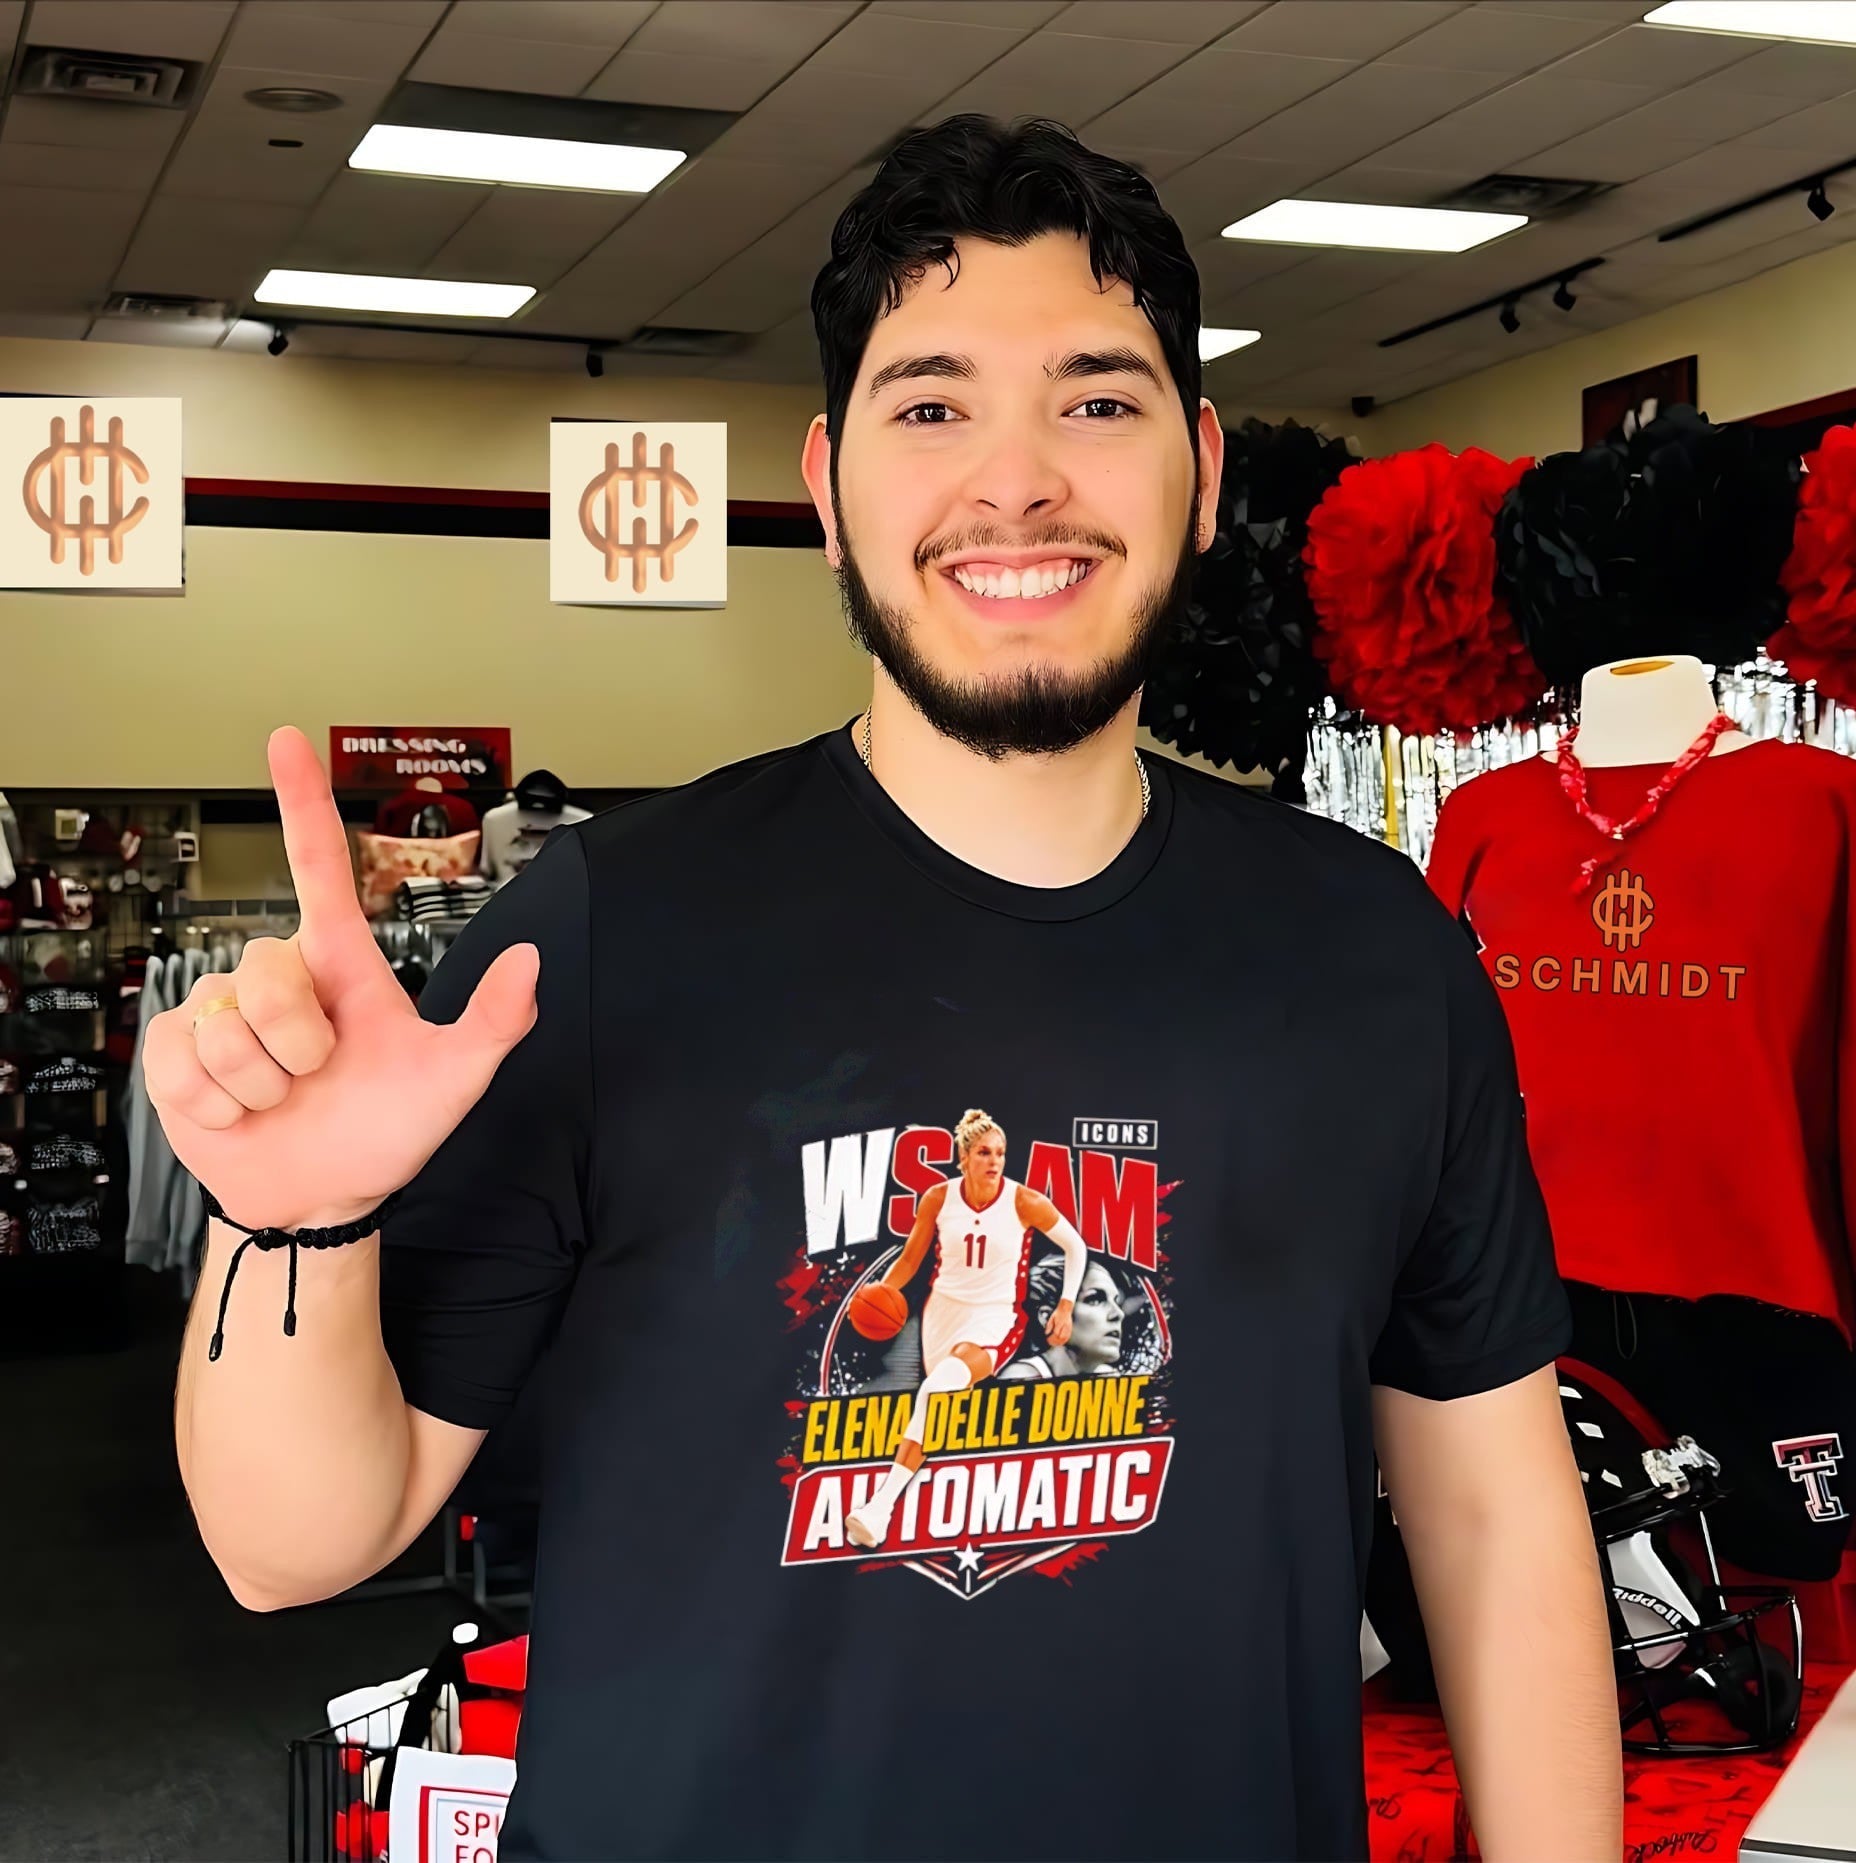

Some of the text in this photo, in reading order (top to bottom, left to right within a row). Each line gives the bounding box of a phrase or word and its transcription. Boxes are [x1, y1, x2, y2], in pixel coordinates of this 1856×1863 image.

[342, 737, 466, 753] DRESSING
[396, 758, 486, 774] ROOMS
[1494, 954, 1746, 1000] SCHMIDT
[1081, 1122, 1150, 1145] ICONS
[801, 1126, 1158, 1272] WSAM
[963, 1233, 986, 1269] 11
[802, 1375, 1151, 1464] ELENA DELLE DONNE
